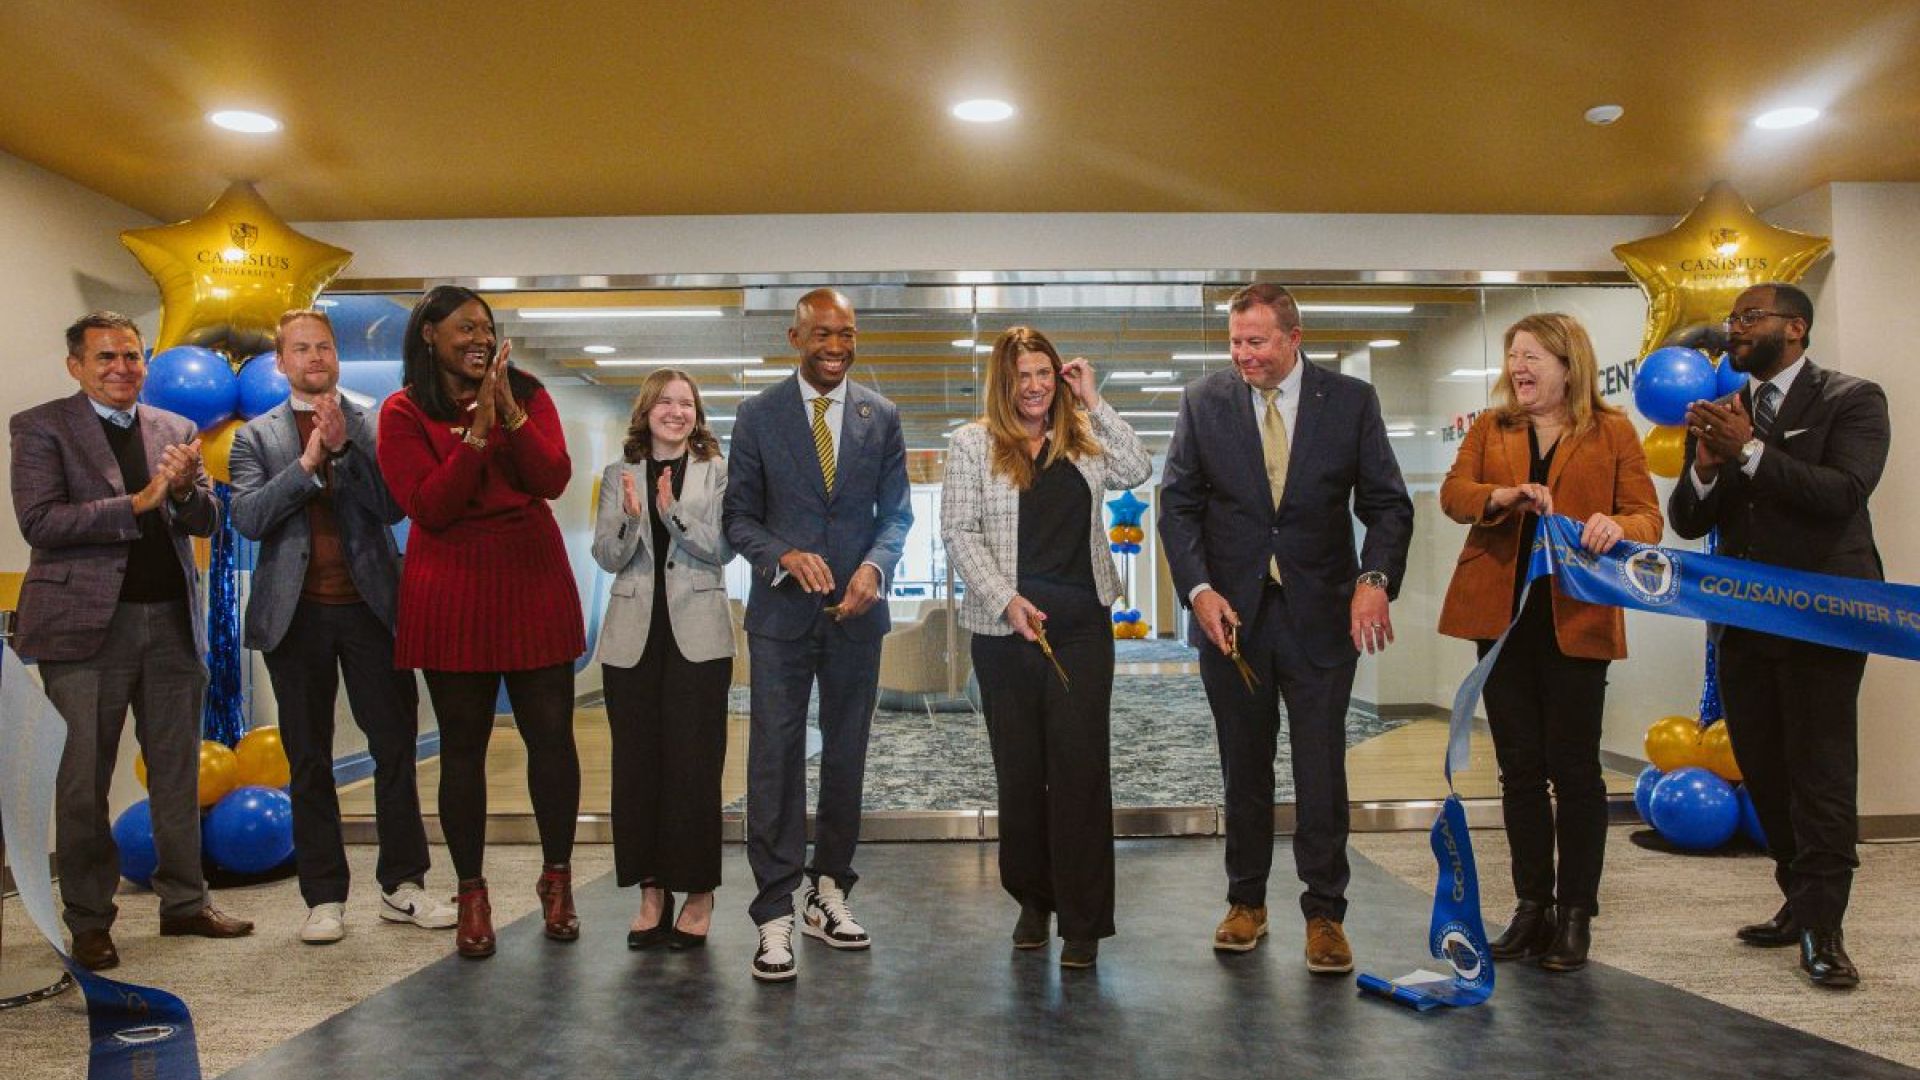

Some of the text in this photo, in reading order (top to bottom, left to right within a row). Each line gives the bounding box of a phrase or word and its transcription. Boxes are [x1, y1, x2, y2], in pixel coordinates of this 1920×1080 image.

[197, 250, 289, 270] CAISIUS
[1681, 257, 1768, 271] CANISIUS
[1700, 575, 1810, 610] GOLISANO
[1813, 594, 1890, 624] CENTER
